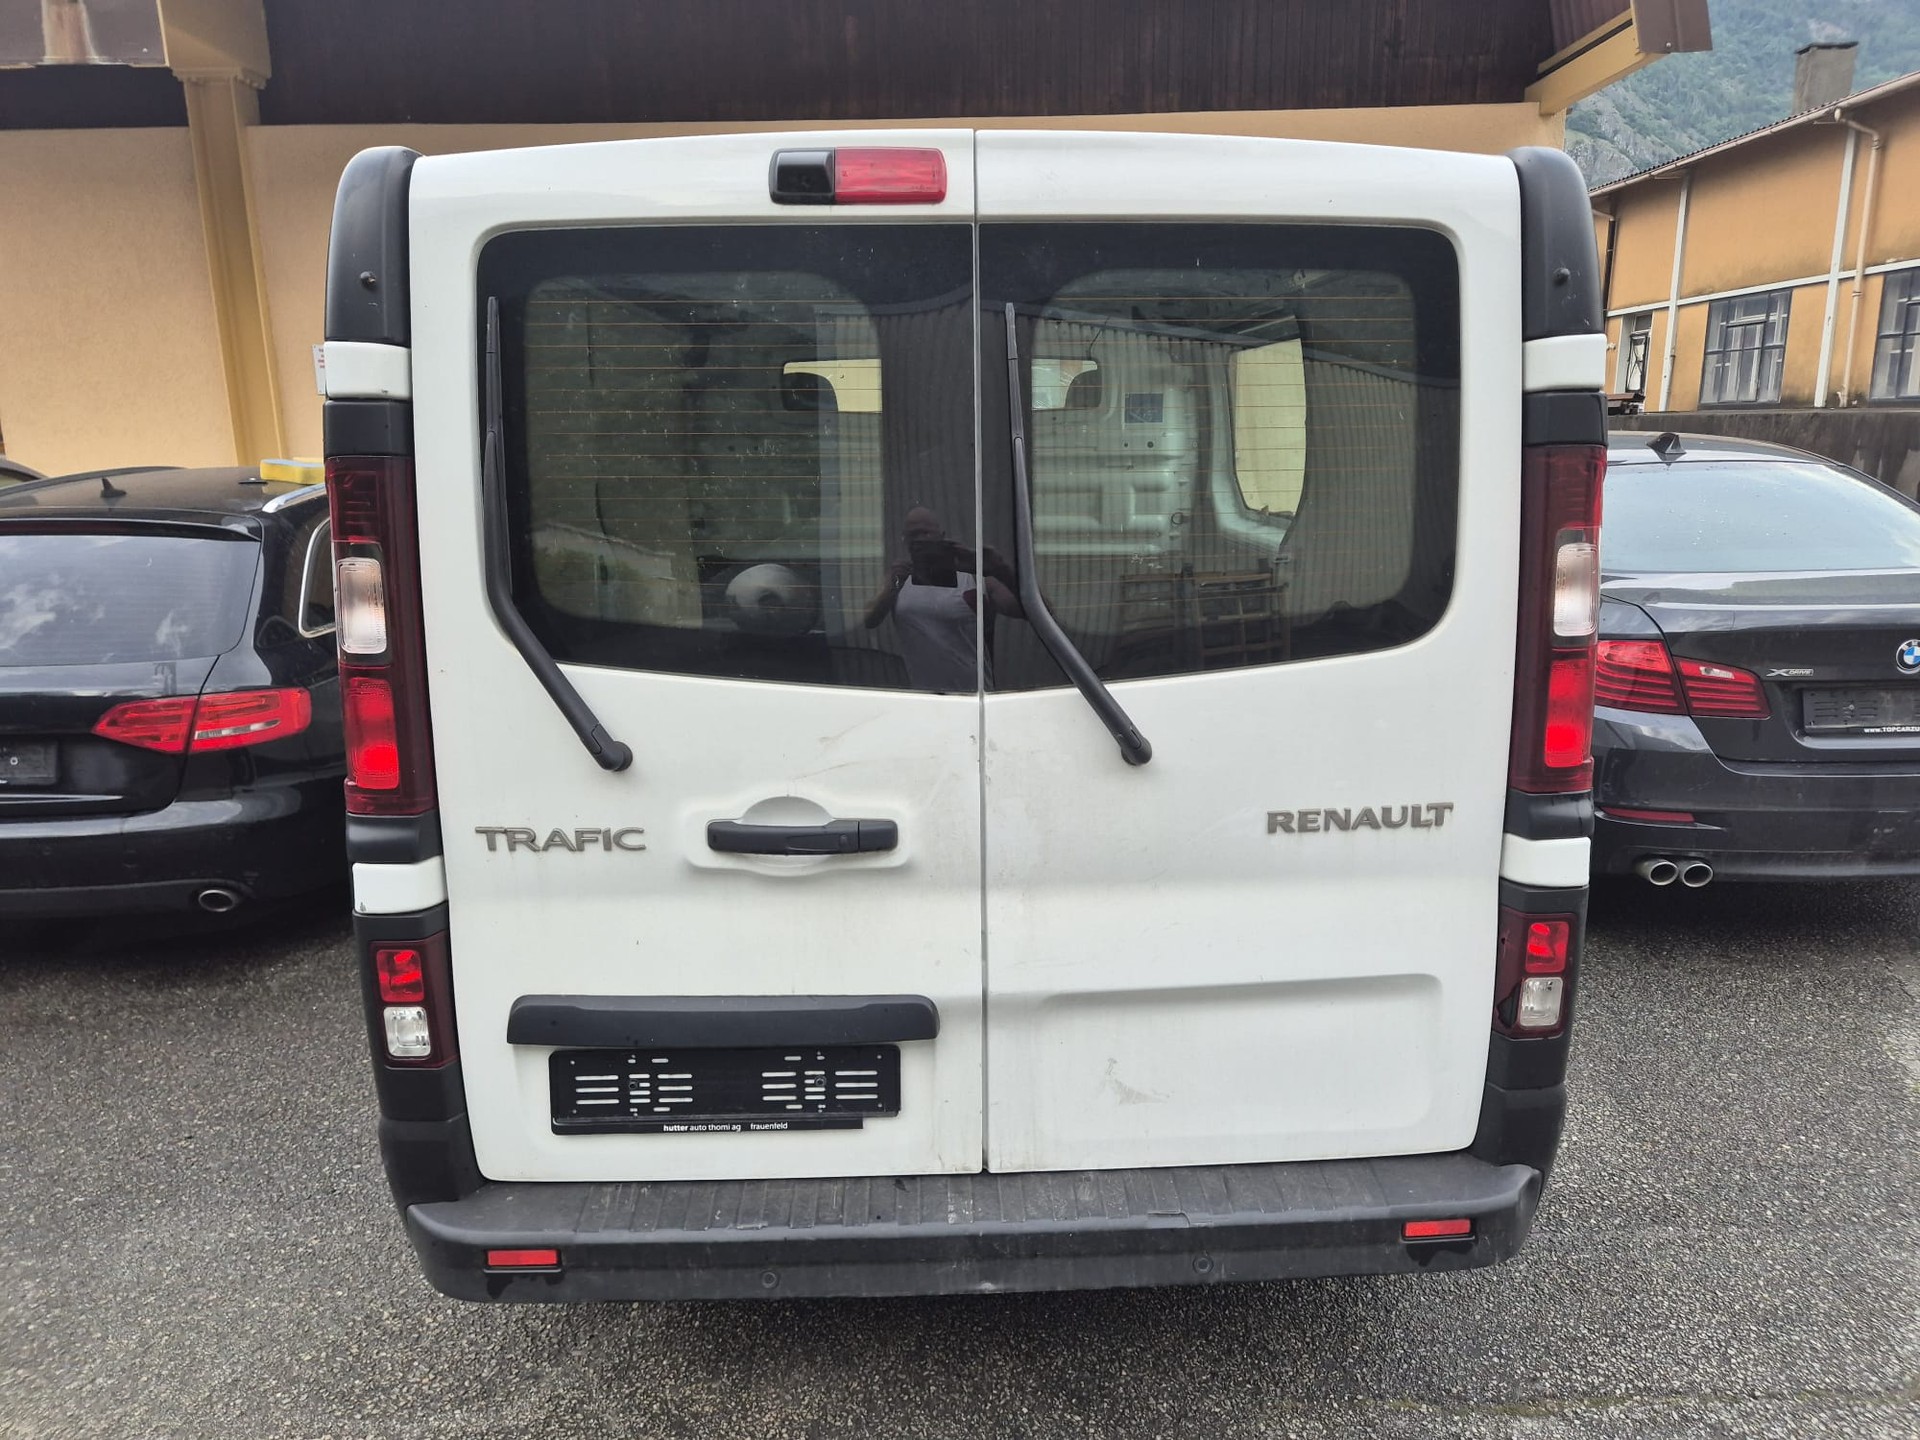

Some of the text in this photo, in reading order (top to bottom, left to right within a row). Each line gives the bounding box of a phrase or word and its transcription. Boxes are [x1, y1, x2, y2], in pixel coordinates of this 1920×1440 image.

[1267, 802, 1454, 834] RENAULT
[475, 827, 646, 852] TRAFIC
[663, 1124, 688, 1132] hutter
[731, 1124, 741, 1132] ag
[750, 1122, 788, 1130] frauenfeld
